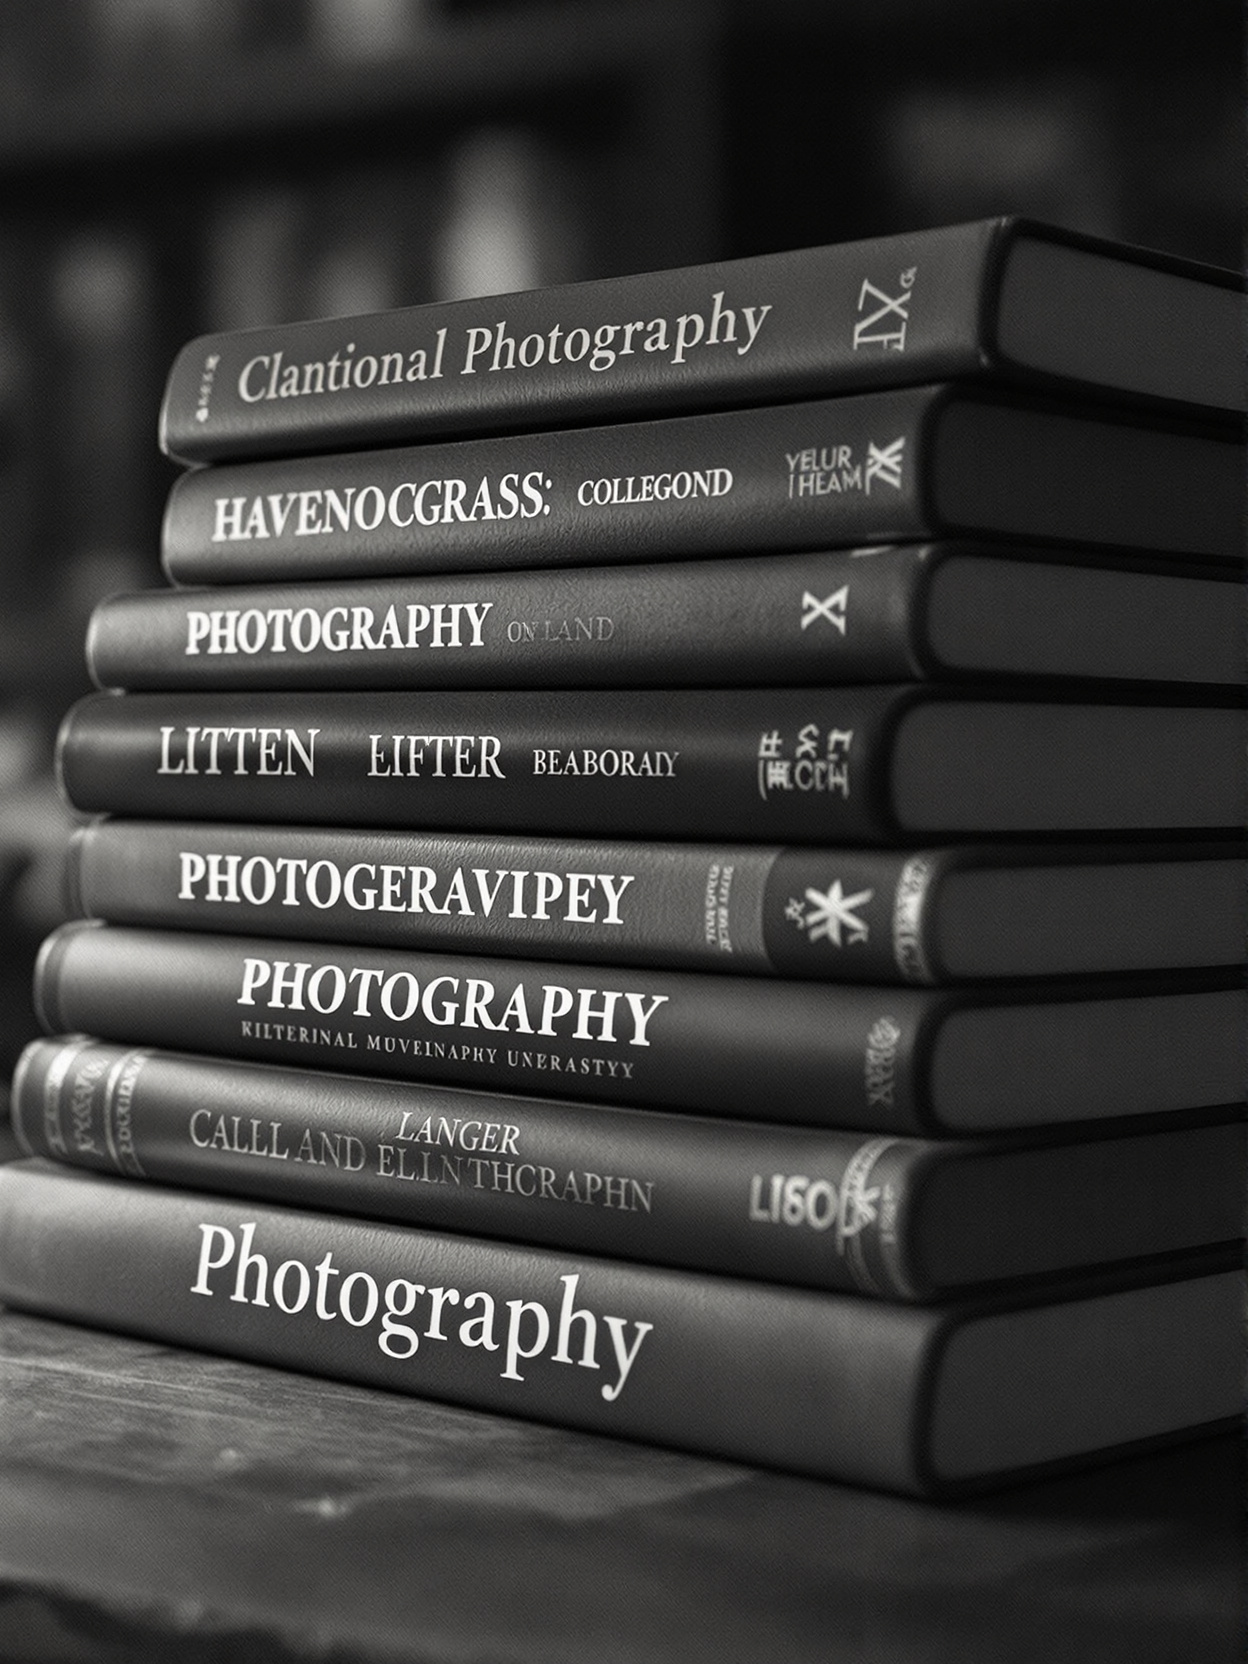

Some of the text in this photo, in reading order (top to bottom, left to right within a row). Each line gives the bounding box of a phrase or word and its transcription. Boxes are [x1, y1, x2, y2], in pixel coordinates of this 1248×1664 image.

[238, 328, 445, 402] Clantional
[460, 290, 773, 372] Photography
[211, 468, 734, 543] HAVENOCGRASS: COLLEGOND
[185, 602, 494, 655] PHOTOGRAPHY
[156, 726, 321, 777] LITTEN
[178, 851, 636, 925] PHOTOGERAVIPEY
[237, 957, 670, 1047] PHOTOGRAPHY
[293, 1127, 367, 1173] AND
[394, 1111, 521, 1156] LANGER
[190, 1221, 654, 1402] Photography
